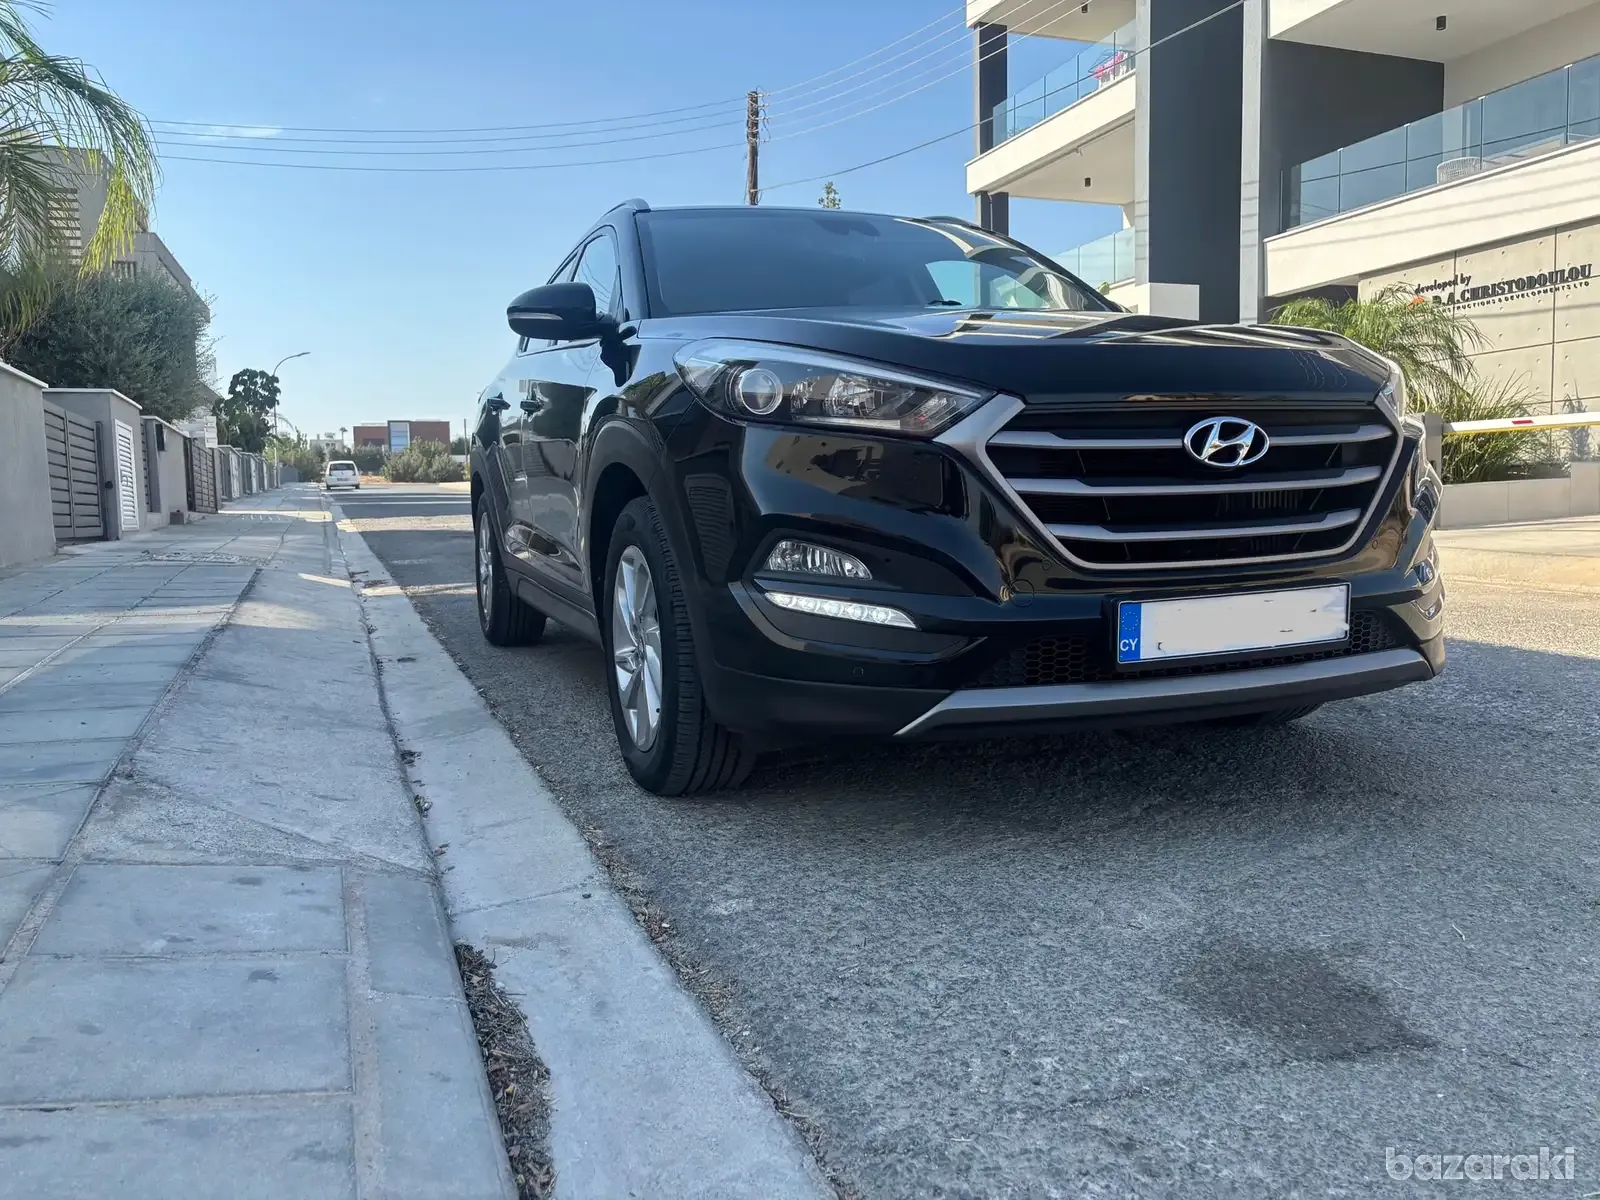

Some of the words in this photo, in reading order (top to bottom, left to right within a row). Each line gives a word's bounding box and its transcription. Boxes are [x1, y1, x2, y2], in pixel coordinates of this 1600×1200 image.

[1414, 274, 1459, 295] developed
[1460, 272, 1472, 287] by
[1504, 284, 1571, 302] DEVELOPMENTS
[1573, 281, 1590, 289] LTD
[1120, 638, 1138, 652] CY
